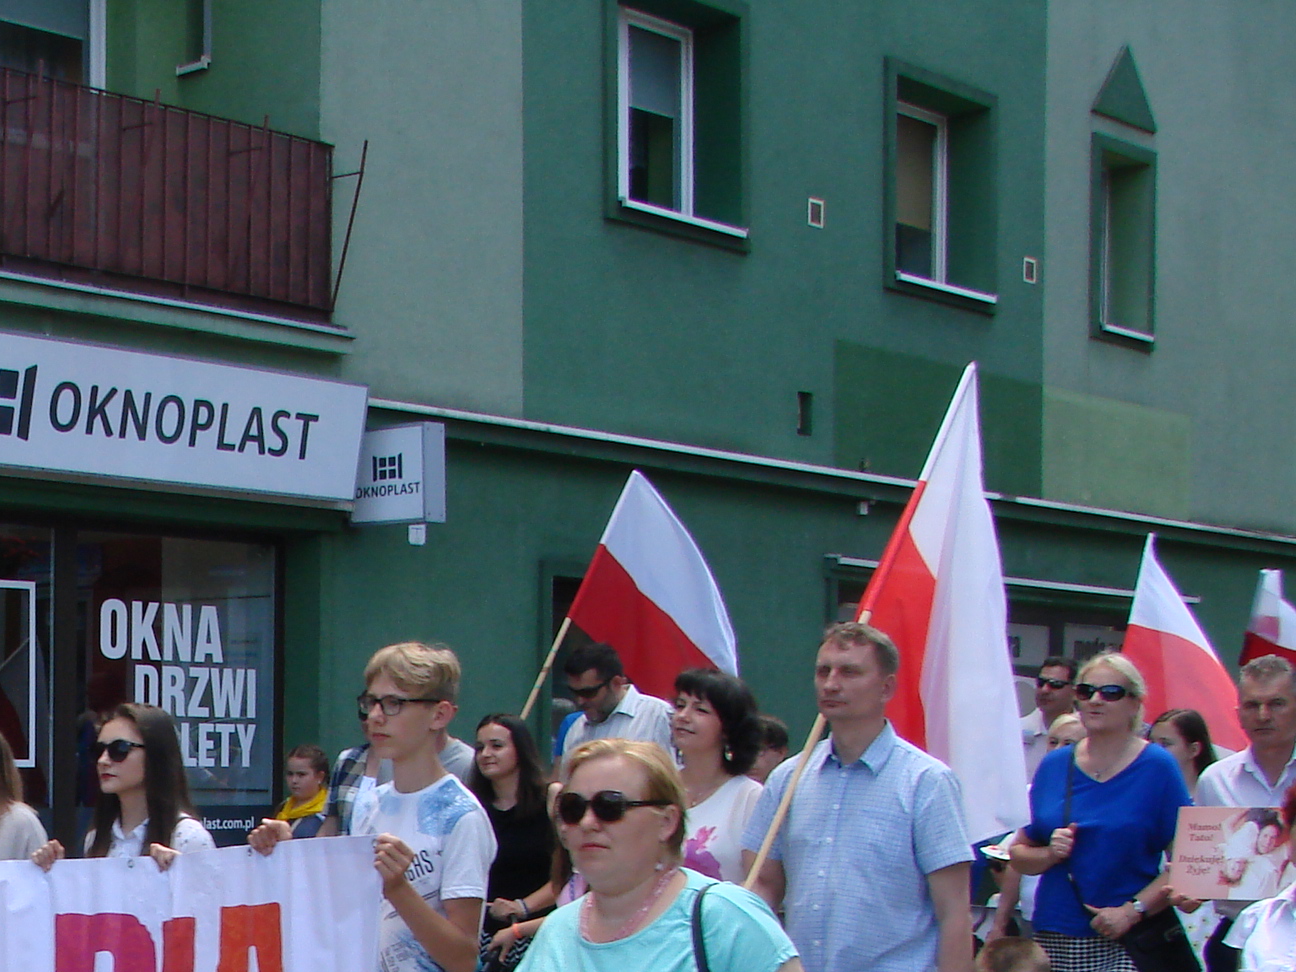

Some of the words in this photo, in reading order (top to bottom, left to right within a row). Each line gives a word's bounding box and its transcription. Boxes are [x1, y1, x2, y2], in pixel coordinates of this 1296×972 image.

[48, 381, 320, 461] OKNOPLAST
[356, 482, 420, 499] OKNOPLAST
[100, 598, 223, 663] OKNA
[134, 664, 257, 719] DRZWI
[183, 721, 256, 769] LETY
[203, 816, 255, 832] last.com.pl
